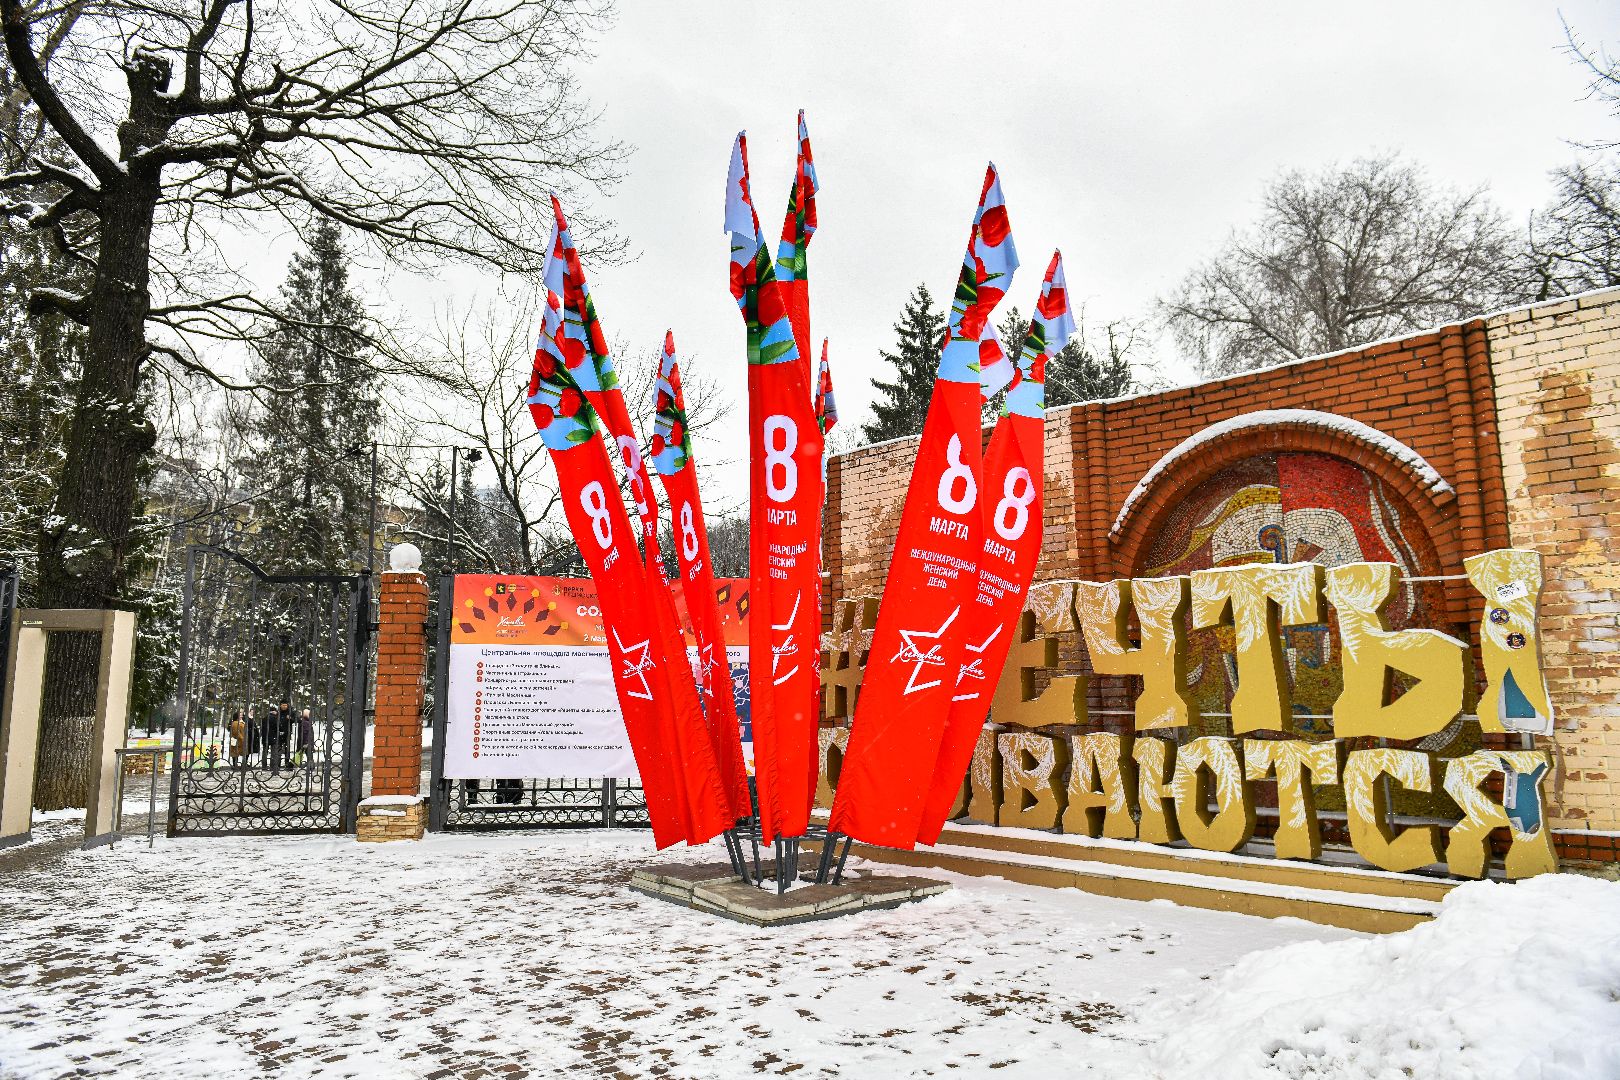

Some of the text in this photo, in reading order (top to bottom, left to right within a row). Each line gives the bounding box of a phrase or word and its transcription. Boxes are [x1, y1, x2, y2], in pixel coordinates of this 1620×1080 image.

[764, 415, 798, 503] 8
[580, 480, 613, 550] 8
[993, 466, 1037, 541] 8
[680, 500, 699, 562] 8
[929, 516, 969, 541] МАРТА
[769, 555, 796, 568] ЕНСКИЙ
[910, 548, 977, 574] МЕЖДУНАРОДНЫЙ
[983, 538, 1017, 565] МАРТА
[922, 562, 959, 580] ЖЕНСКИЙ
[927, 575, 948, 589] ДЕНЬ
[975, 592, 994, 607] ДЕНЬ
[583, 633, 589, 642] 2
[821, 548, 1552, 742] #ЕЧТЫ
